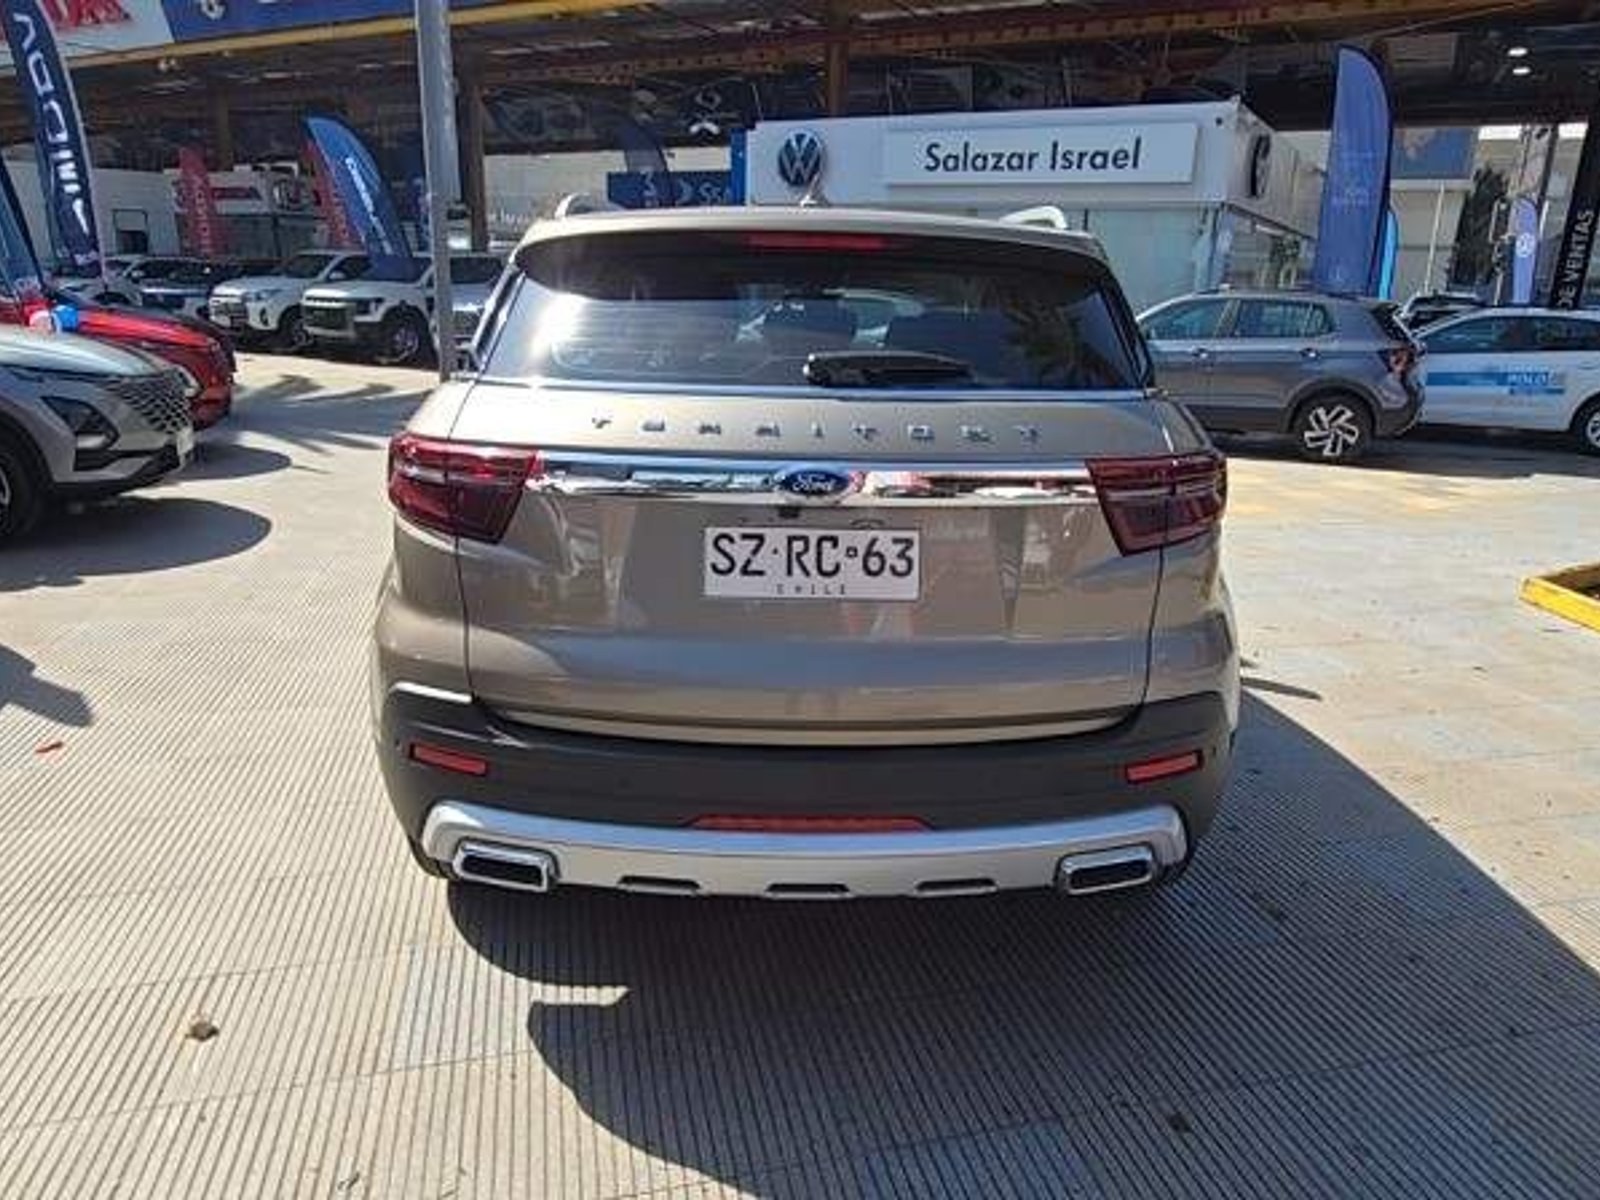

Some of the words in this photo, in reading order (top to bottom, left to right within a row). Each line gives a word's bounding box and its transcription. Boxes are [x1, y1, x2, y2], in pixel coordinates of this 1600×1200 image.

[924, 141, 1039, 173] Salazar
[1049, 135, 1142, 171] Israel
[1561, 210, 1594, 283] VENTAS
